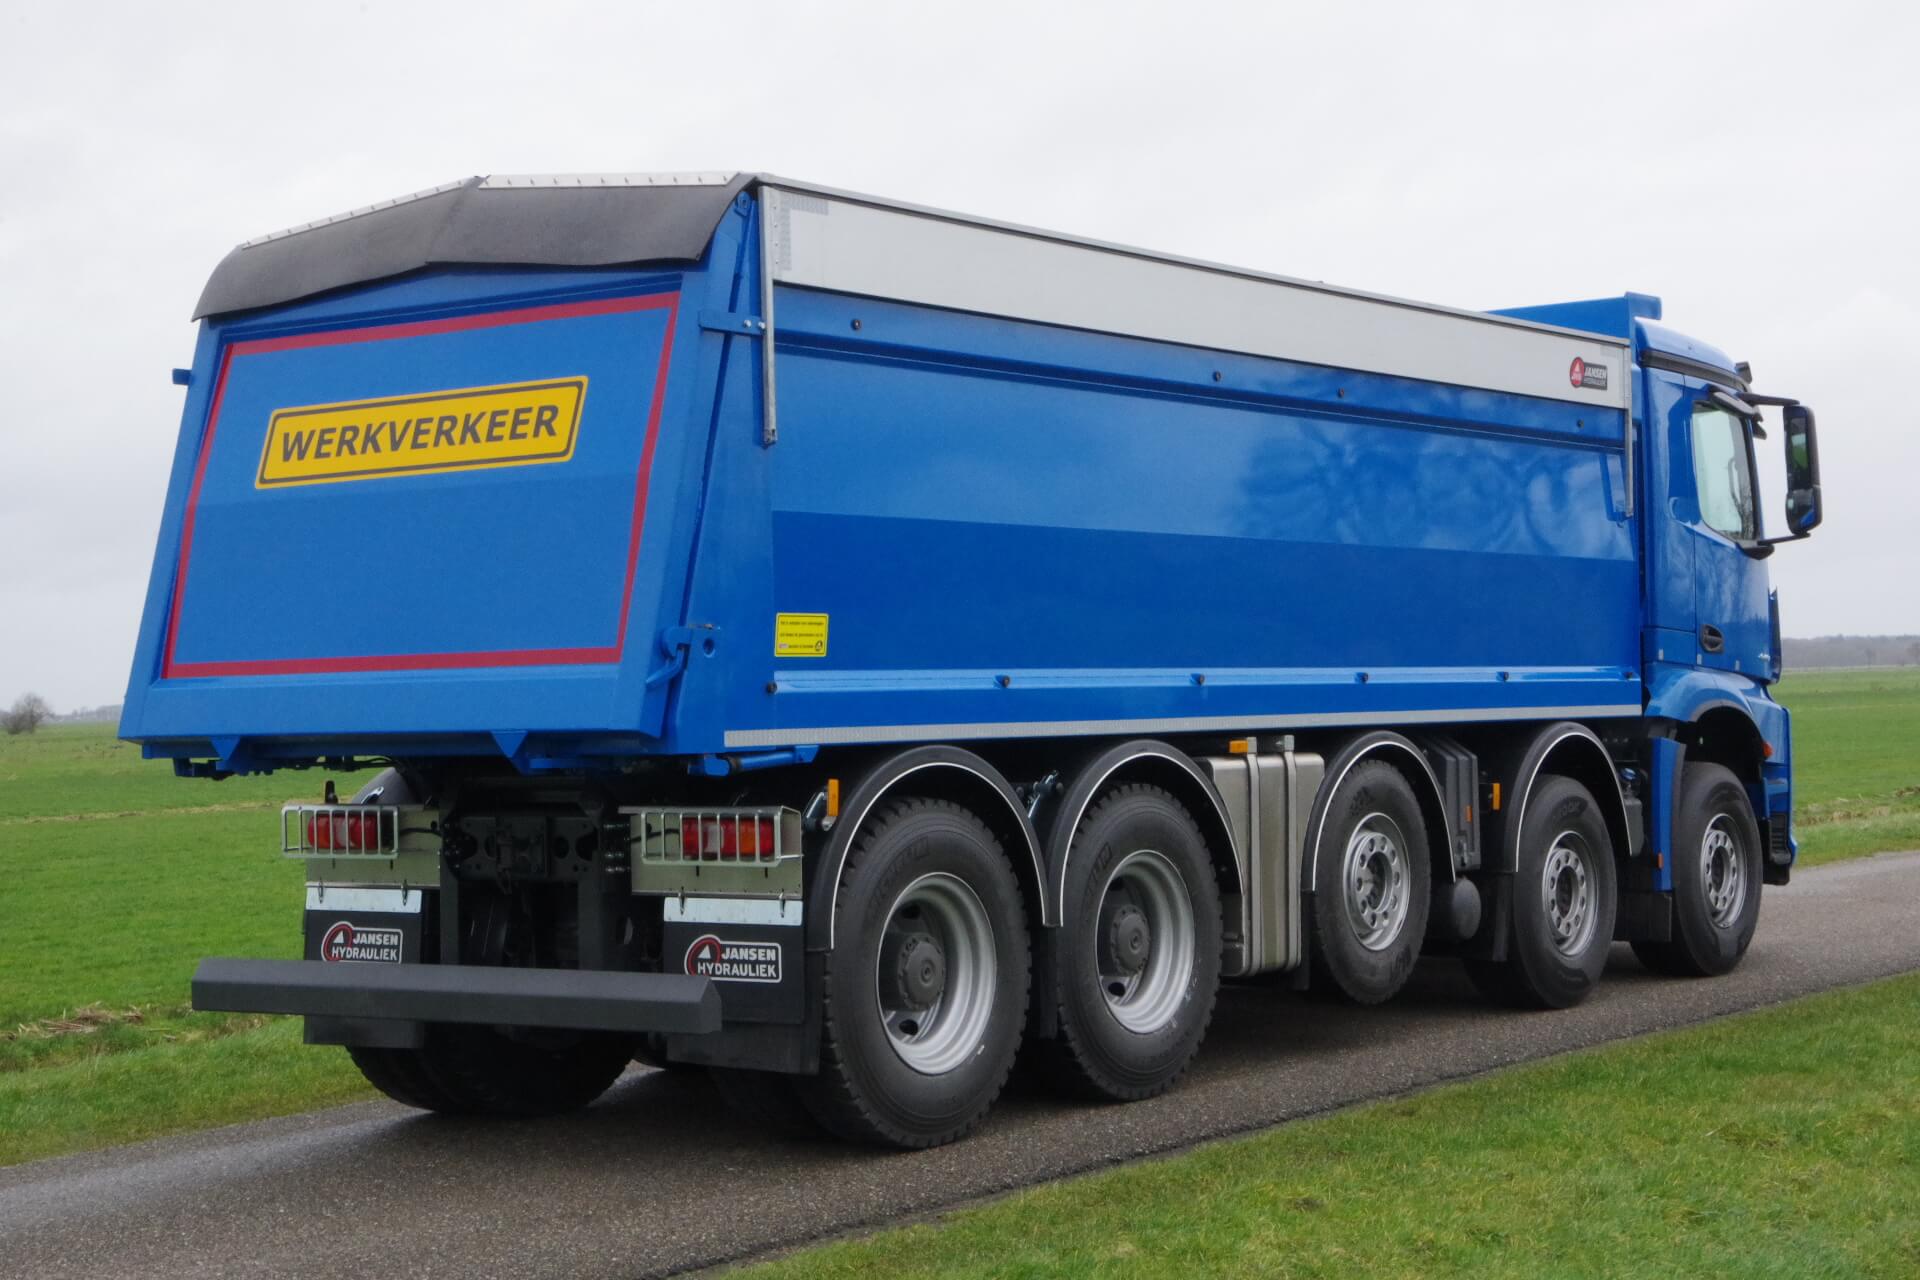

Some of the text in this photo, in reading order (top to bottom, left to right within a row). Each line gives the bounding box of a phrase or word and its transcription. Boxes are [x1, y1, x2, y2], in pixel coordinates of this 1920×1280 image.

[281, 404, 559, 462] WERKVERKEER
[352, 933, 398, 946] JANSEN
[331, 946, 397, 961] HYDRAULIEK
[721, 947, 776, 961] JANSEN
[697, 961, 777, 978] HYDRAULIEK
